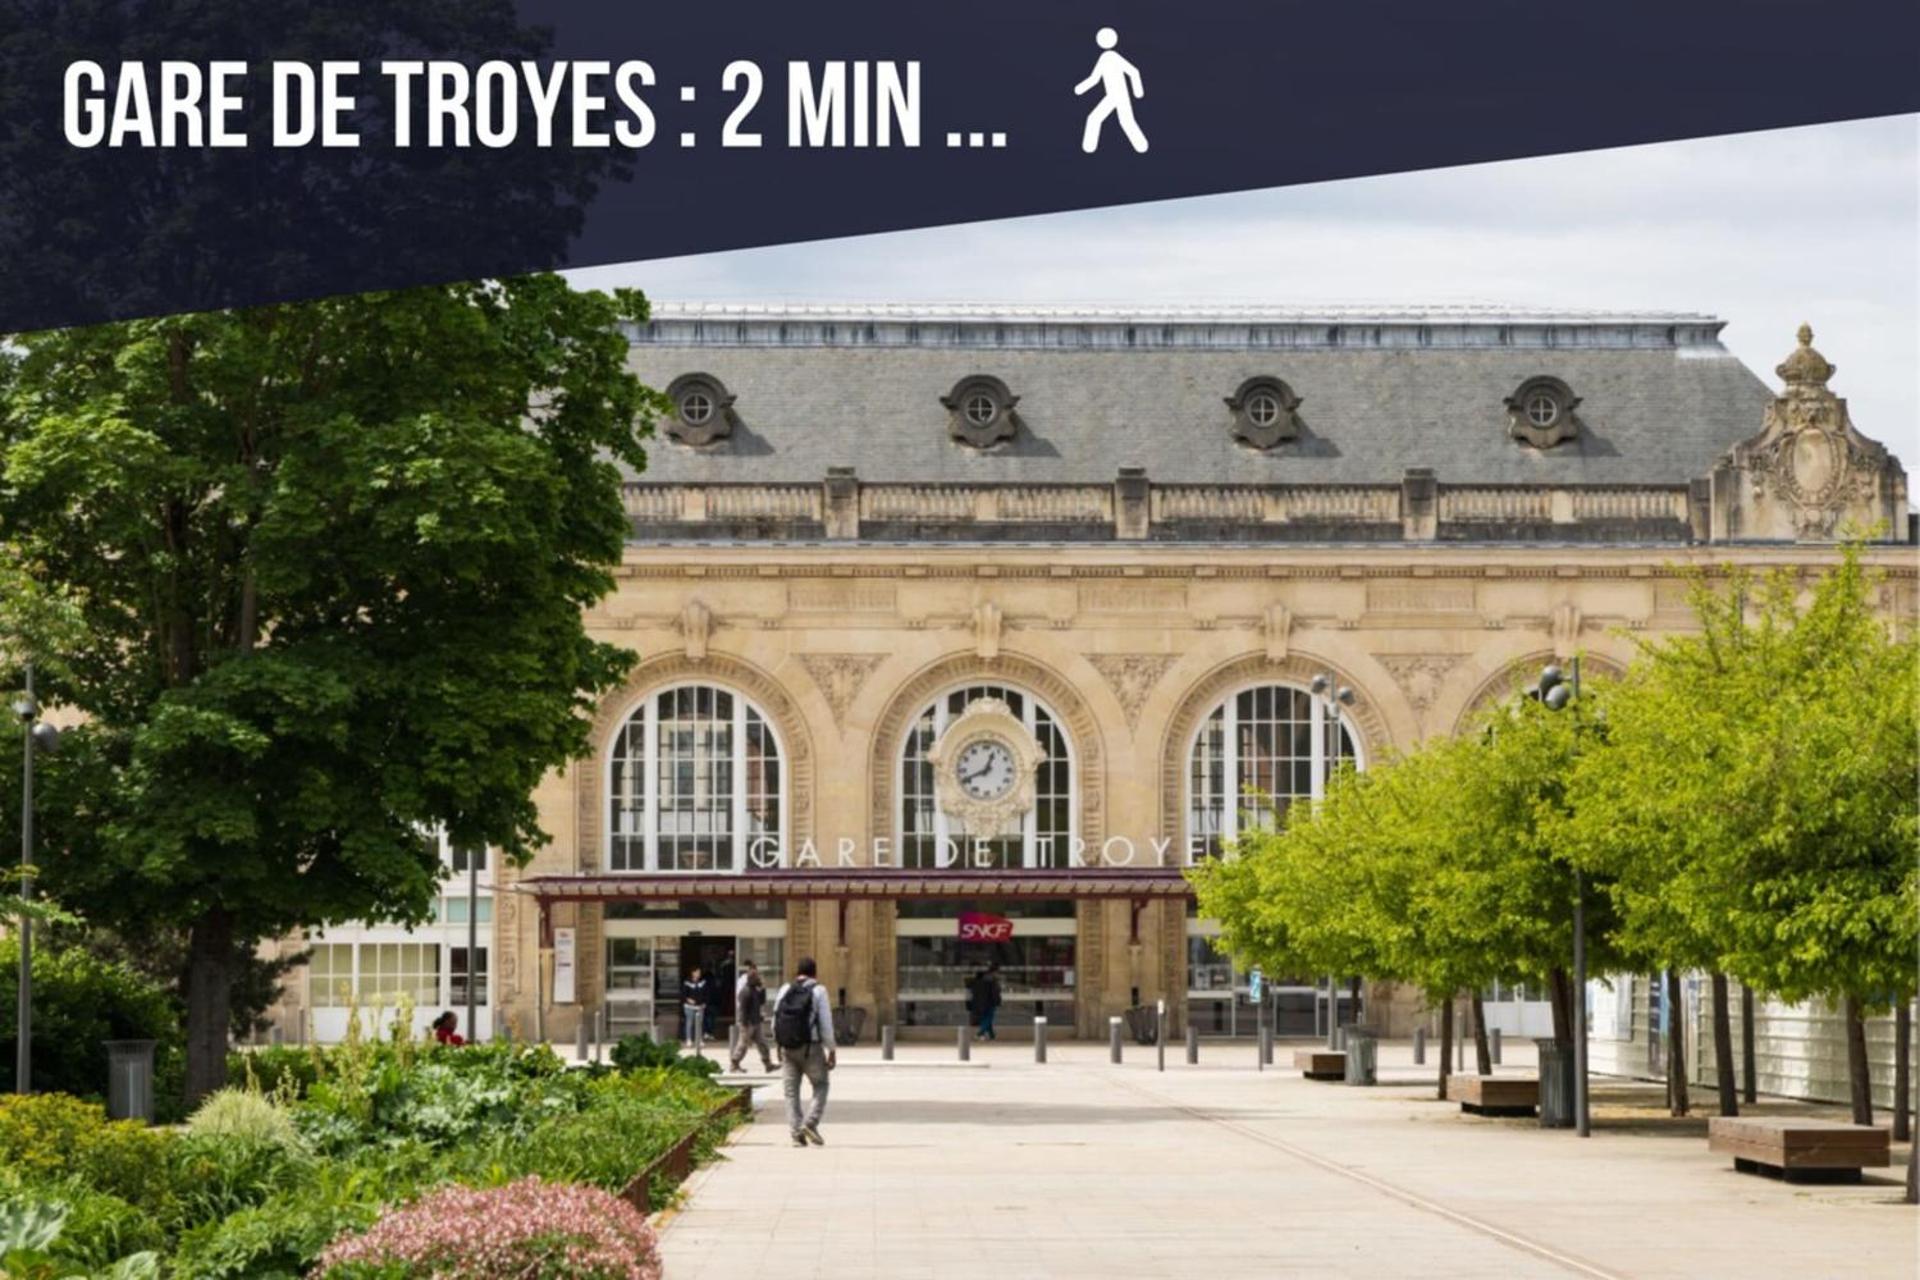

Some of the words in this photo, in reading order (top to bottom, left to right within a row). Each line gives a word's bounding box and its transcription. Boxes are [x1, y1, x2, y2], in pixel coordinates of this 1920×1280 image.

[749, 836, 890, 868] GARE
[938, 836, 992, 868] DE
[1034, 836, 1205, 868] TROYE
[960, 922, 1010, 939] SNCF
